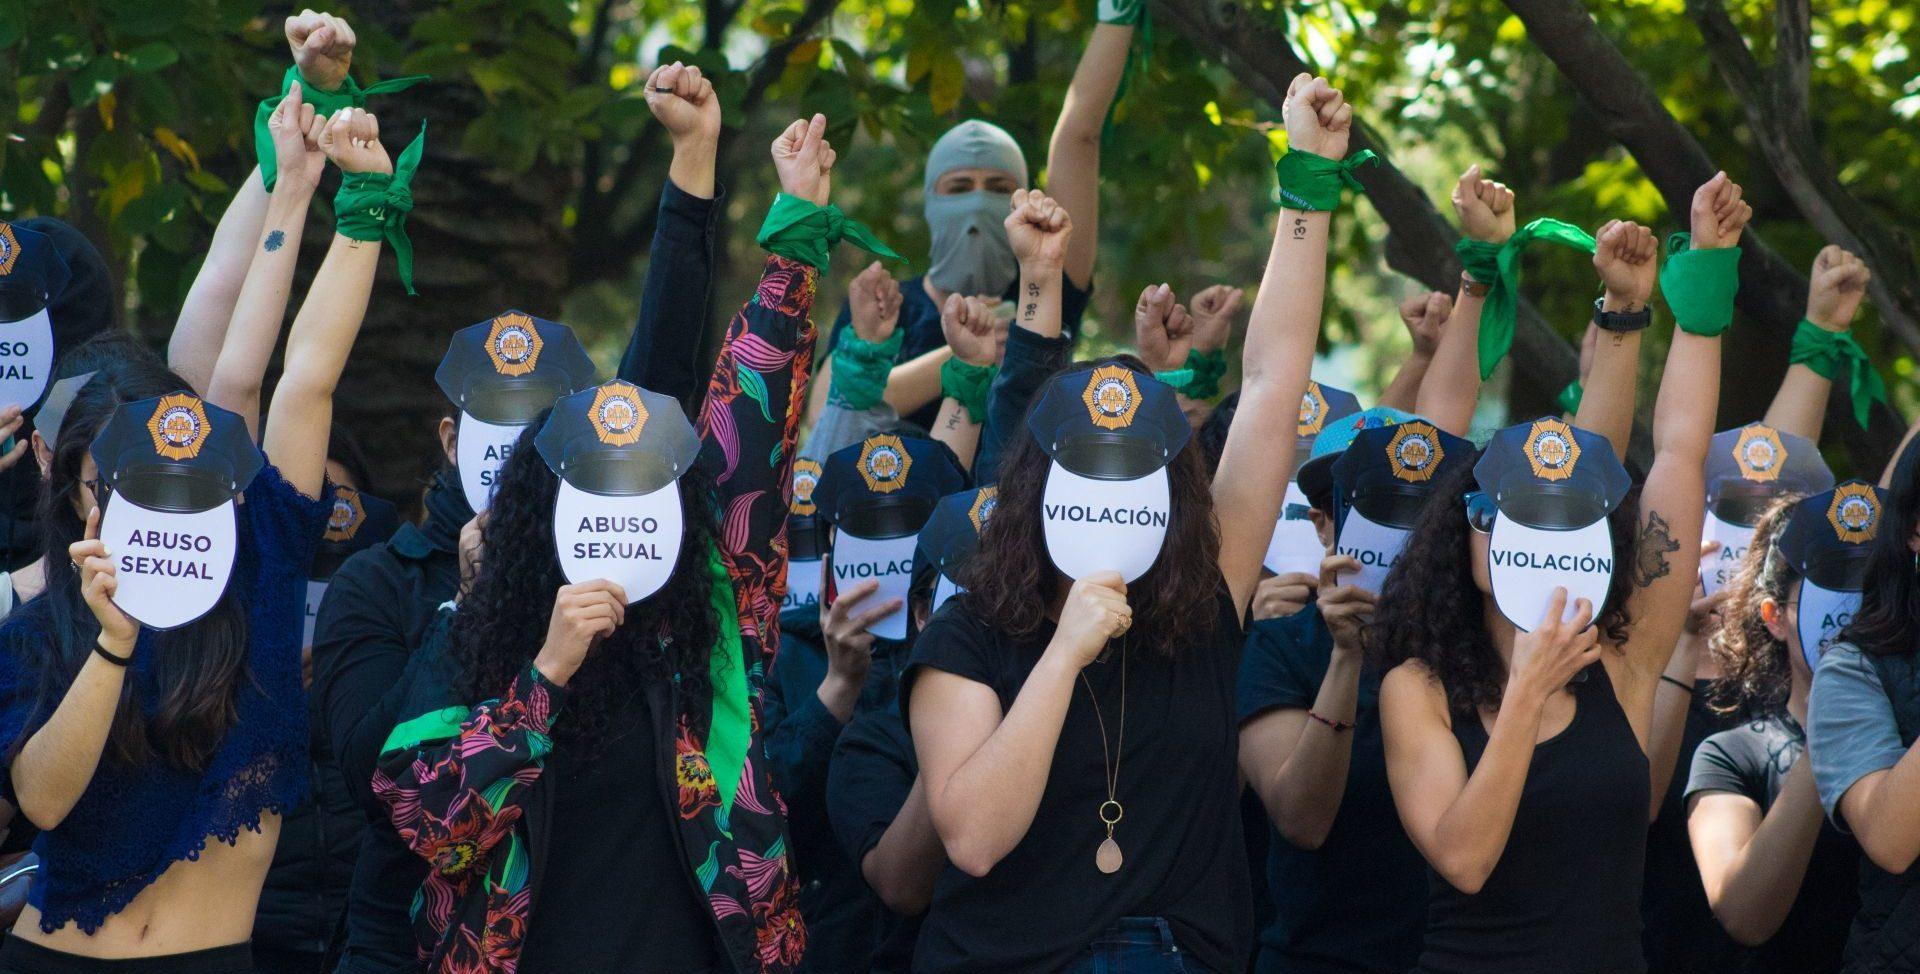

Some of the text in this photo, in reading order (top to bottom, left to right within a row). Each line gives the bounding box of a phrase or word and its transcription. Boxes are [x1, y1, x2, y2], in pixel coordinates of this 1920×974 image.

[577, 516, 658, 533] ABUSO
[1045, 504, 1167, 528] VIOLACIÓN
[128, 529, 212, 552] ABUSO
[574, 542, 662, 560] SEXUAL
[120, 555, 214, 580] SEXUAL
[835, 559, 912, 580] VIOLAC
[1491, 549, 1611, 574] VIOLACIÓN
